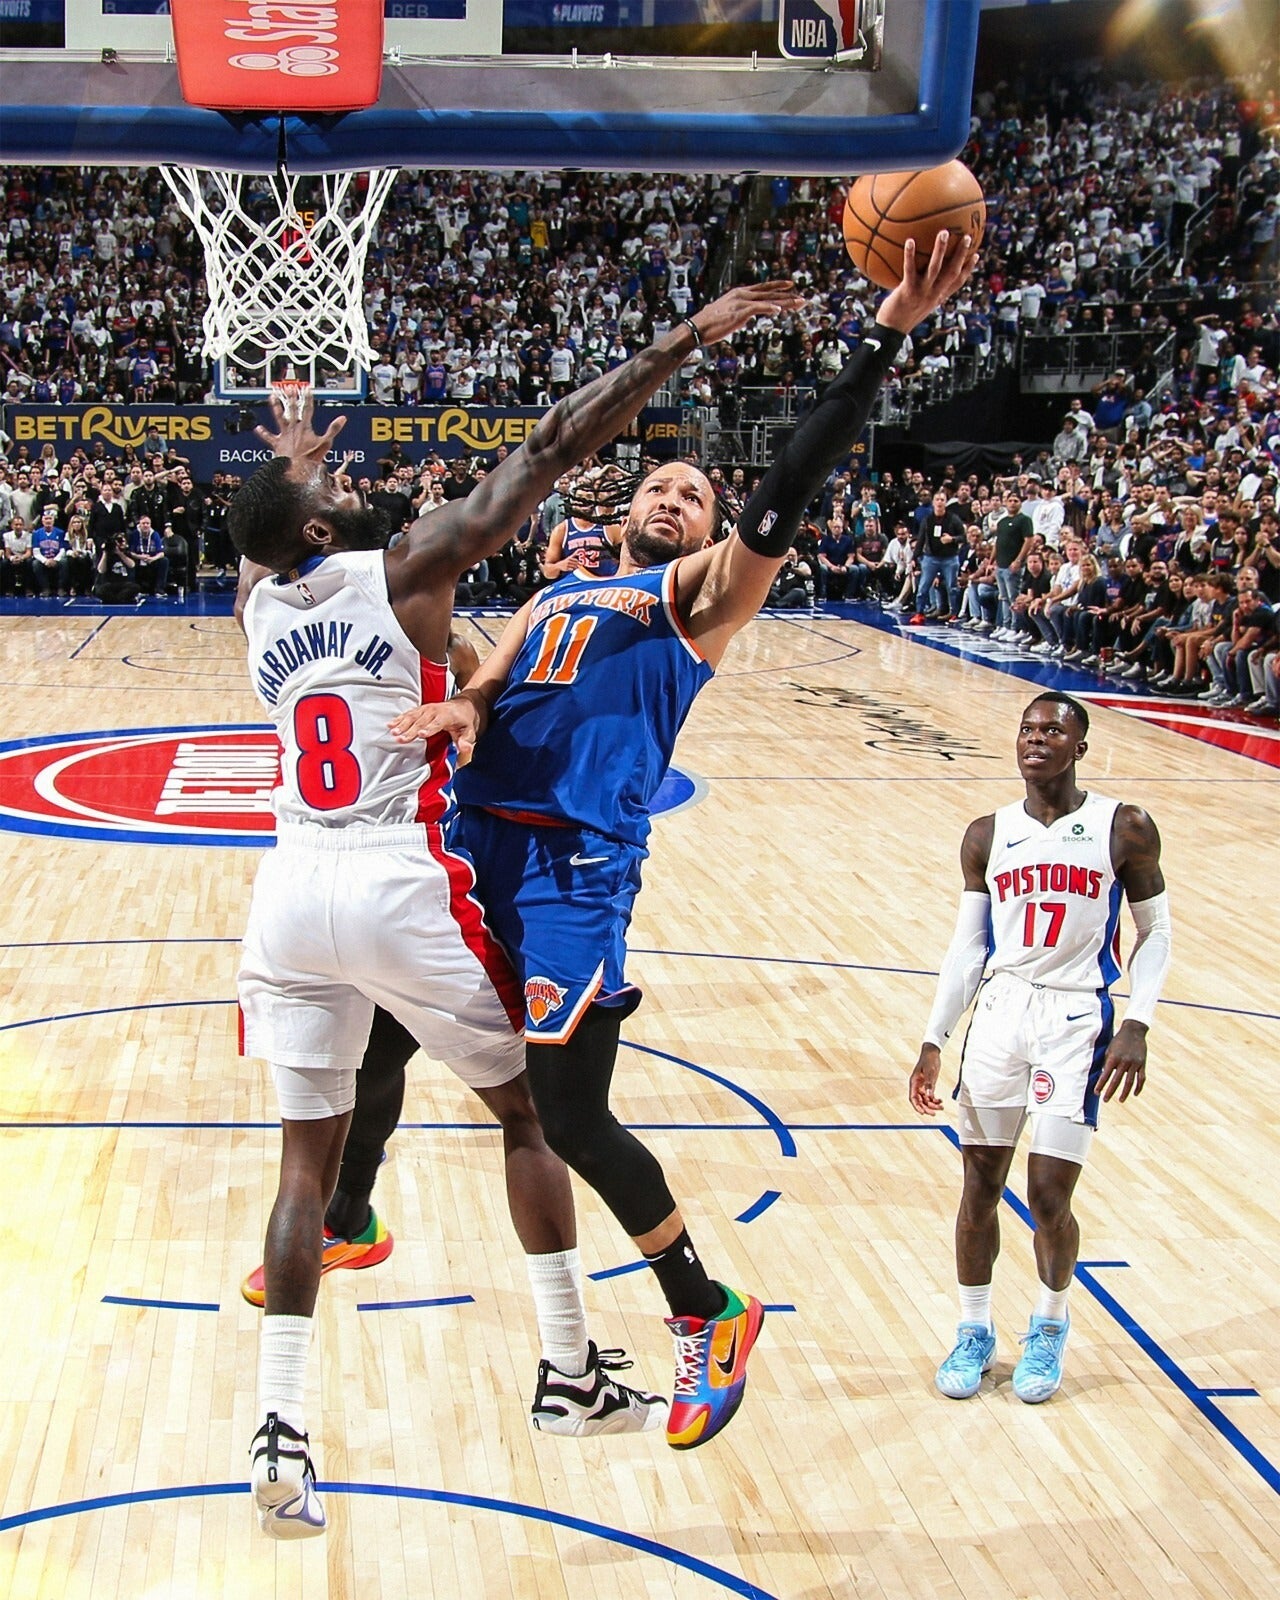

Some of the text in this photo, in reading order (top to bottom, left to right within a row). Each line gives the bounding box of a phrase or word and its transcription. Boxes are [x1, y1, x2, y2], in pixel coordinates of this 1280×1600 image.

[791, 19, 828, 48] NBA
[577, 586, 660, 628] YORK
[257, 620, 393, 706] HARDAWAY JR.
[524, 612, 598, 684] 11
[154, 742, 279, 816] DETROIT
[293, 692, 362, 811] 8
[993, 863, 1104, 903] PISTONS
[1022, 902, 1067, 948] 17
